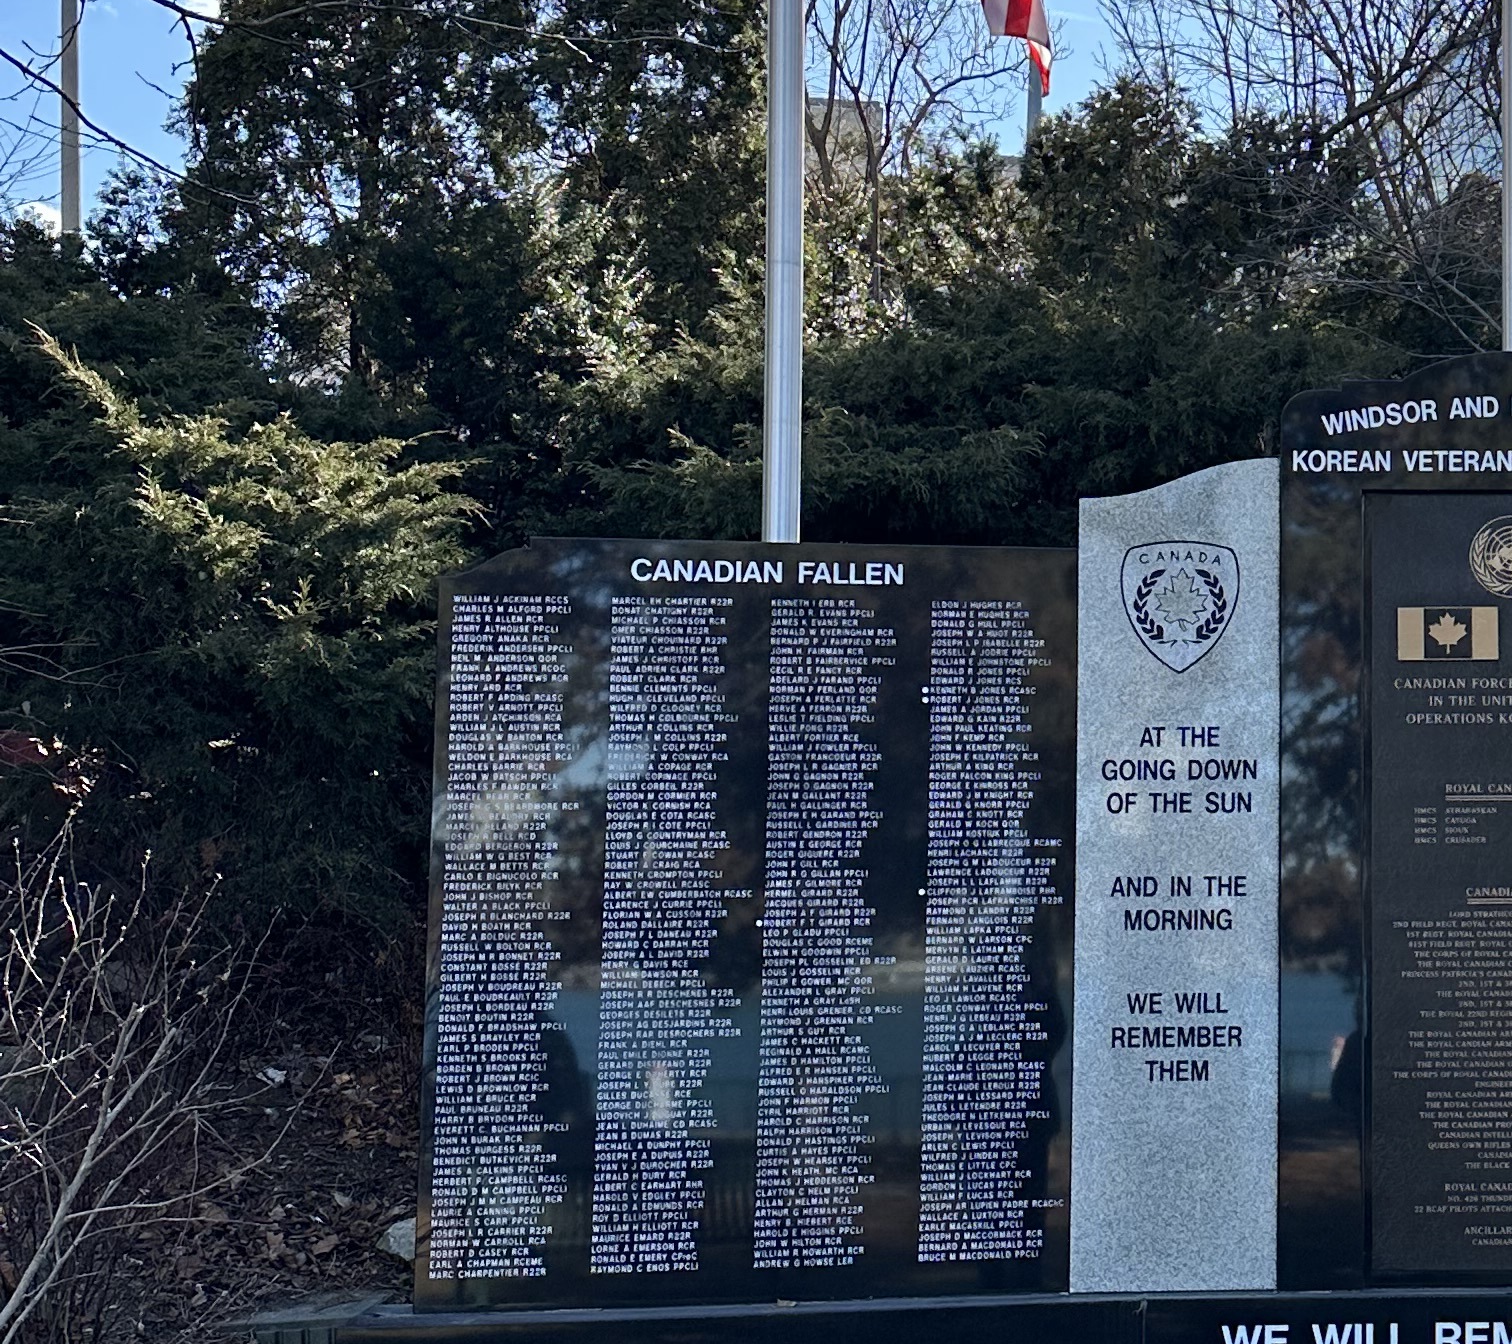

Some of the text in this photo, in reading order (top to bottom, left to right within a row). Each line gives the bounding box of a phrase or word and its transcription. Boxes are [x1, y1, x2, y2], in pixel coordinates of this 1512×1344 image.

[1321, 399, 1438, 436] WINDSOR
[1449, 396, 1499, 420] AND
[1292, 449, 1391, 472] KOREAN
[1139, 551, 1221, 566] CANADA
[630, 558, 904, 585] CANADIAN FALLEN
[1394, 678, 1466, 690] CANADIAN
[1429, 695, 1444, 706] IN
[1451, 695, 1476, 706] THE
[1406, 713, 1493, 725] OPERATIONS
[1140, 727, 1220, 747] AT THE
[1101, 759, 1257, 780] GOING DOWN
[1445, 784, 1484, 794] ROYAL
[1106, 792, 1252, 814] OF THE SUN
[1110, 876, 1247, 897] AND IN THE
[1124, 909, 1233, 931] MORNING
[1127, 993, 1228, 1014] WE WILL
[1111, 1026, 1242, 1048] REMEMBER
[1145, 1060, 1209, 1081] THEM
[1445, 1182, 1477, 1191] ROYAL
